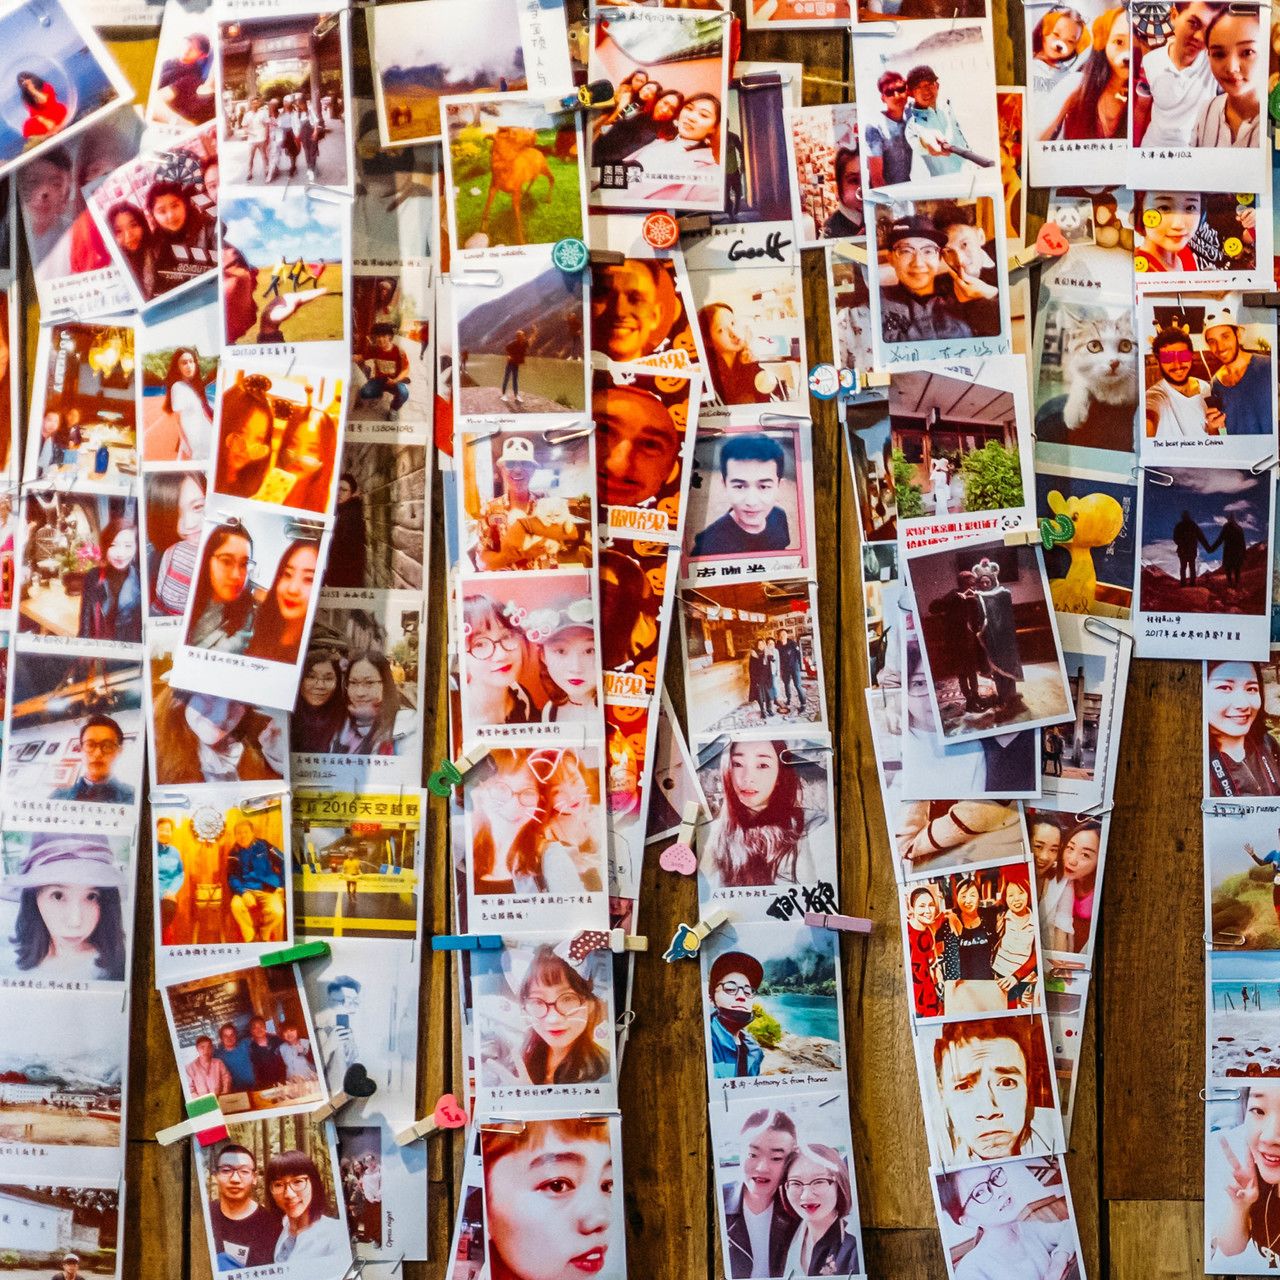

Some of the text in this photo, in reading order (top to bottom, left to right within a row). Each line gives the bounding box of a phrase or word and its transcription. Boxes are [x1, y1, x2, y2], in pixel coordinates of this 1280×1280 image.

[1153, 439, 1164, 447] The
[1167, 439, 1178, 447] best
[1180, 440, 1195, 448] place
